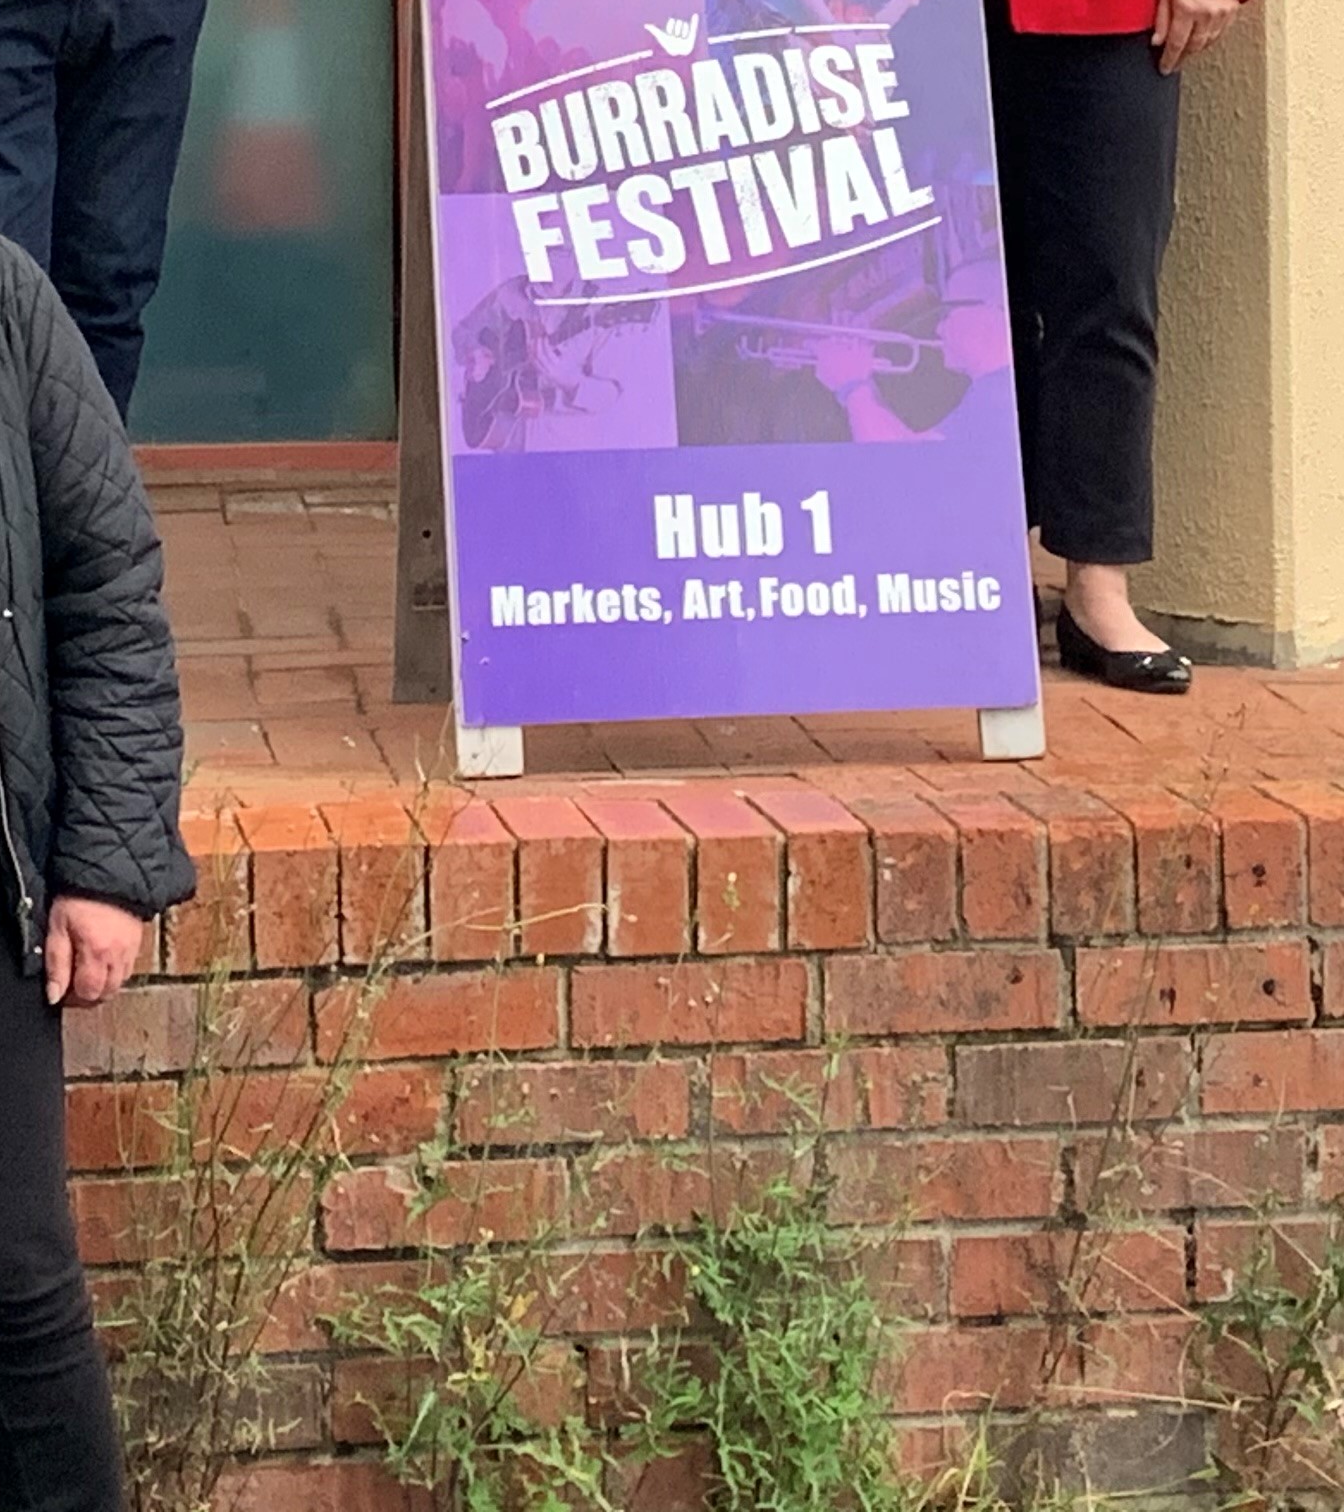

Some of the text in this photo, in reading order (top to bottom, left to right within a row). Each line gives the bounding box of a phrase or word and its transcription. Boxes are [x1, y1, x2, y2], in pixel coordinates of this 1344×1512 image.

[490, 43, 911, 194] BURRADISE
[511, 126, 936, 284] FESTIVAL
[654, 490, 834, 559] Hub 1
[490, 582, 673, 627] Markets,
[876, 570, 1002, 615] Music
